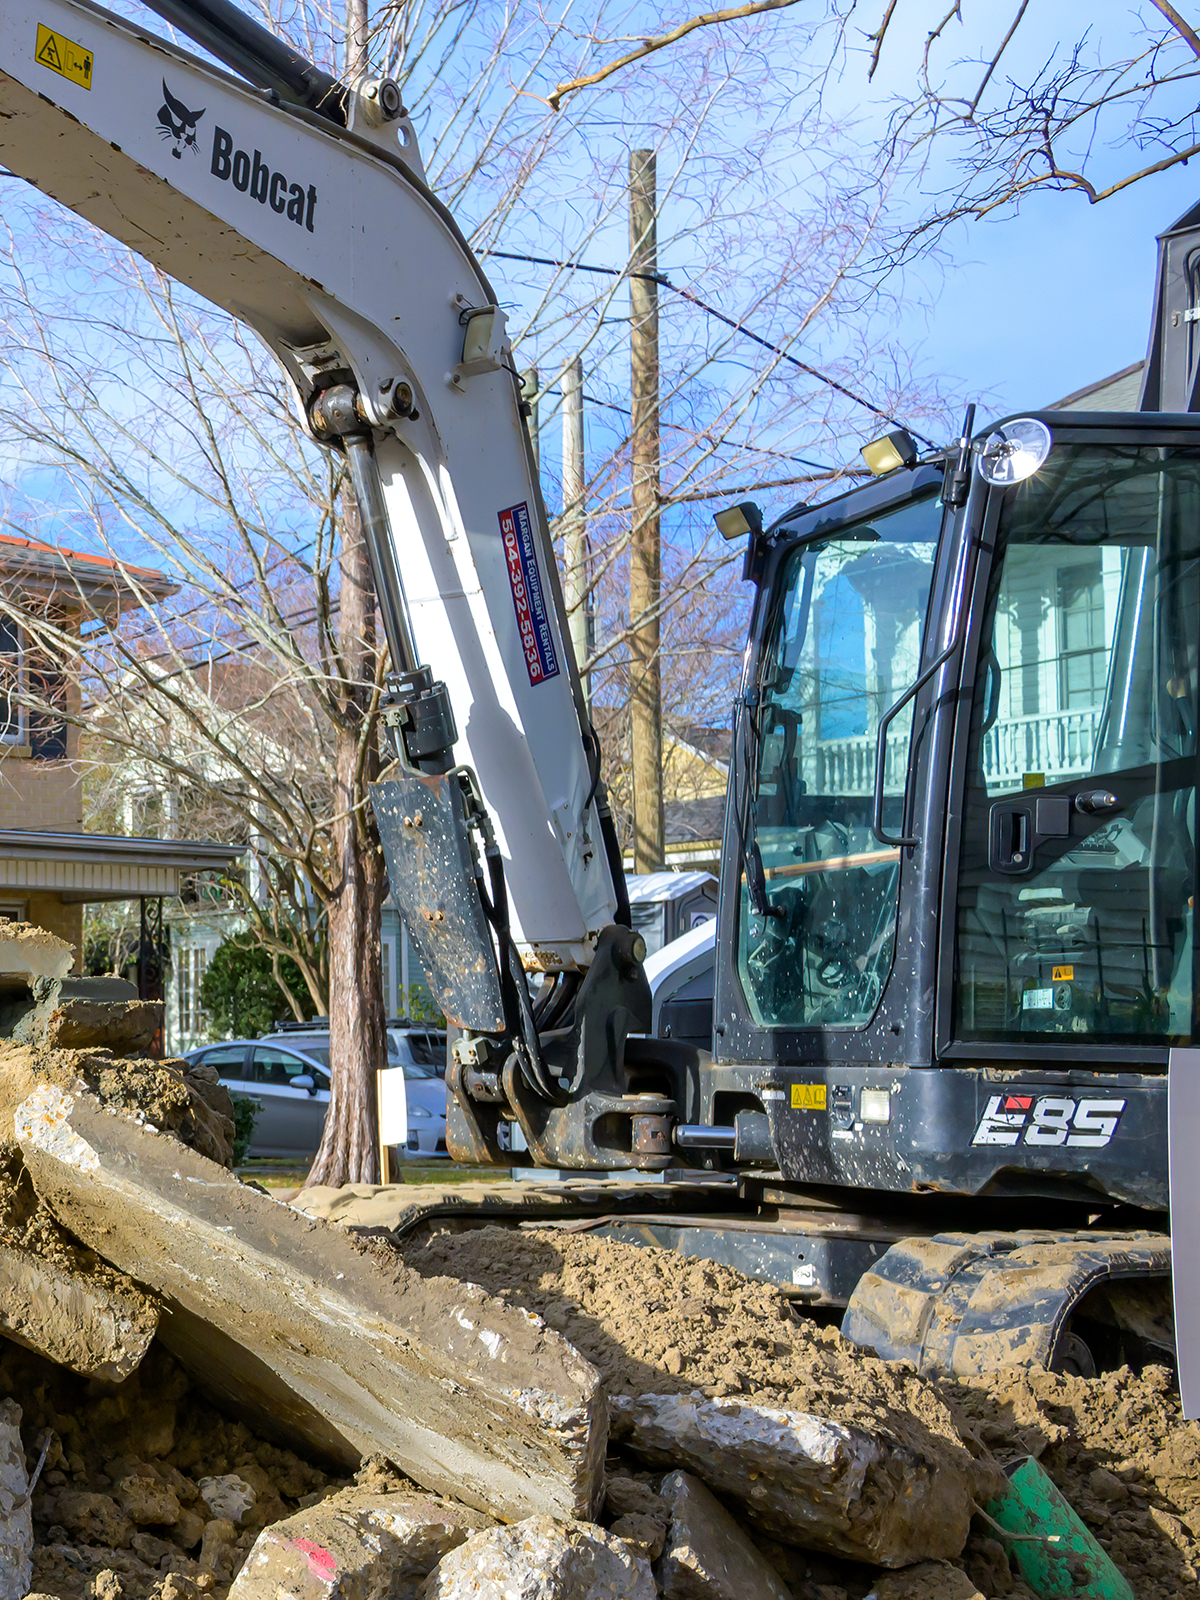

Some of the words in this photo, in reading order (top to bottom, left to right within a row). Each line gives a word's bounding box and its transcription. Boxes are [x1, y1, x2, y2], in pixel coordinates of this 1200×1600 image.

[211, 125, 318, 234] Bobcat
[502, 518, 541, 678] 504-392-5836
[517, 509, 533, 558] MARGAN
[526, 558, 545, 621] EQUIPMENT
[538, 622, 555, 672] RENTALS
[972, 1095, 1127, 1148] E85
